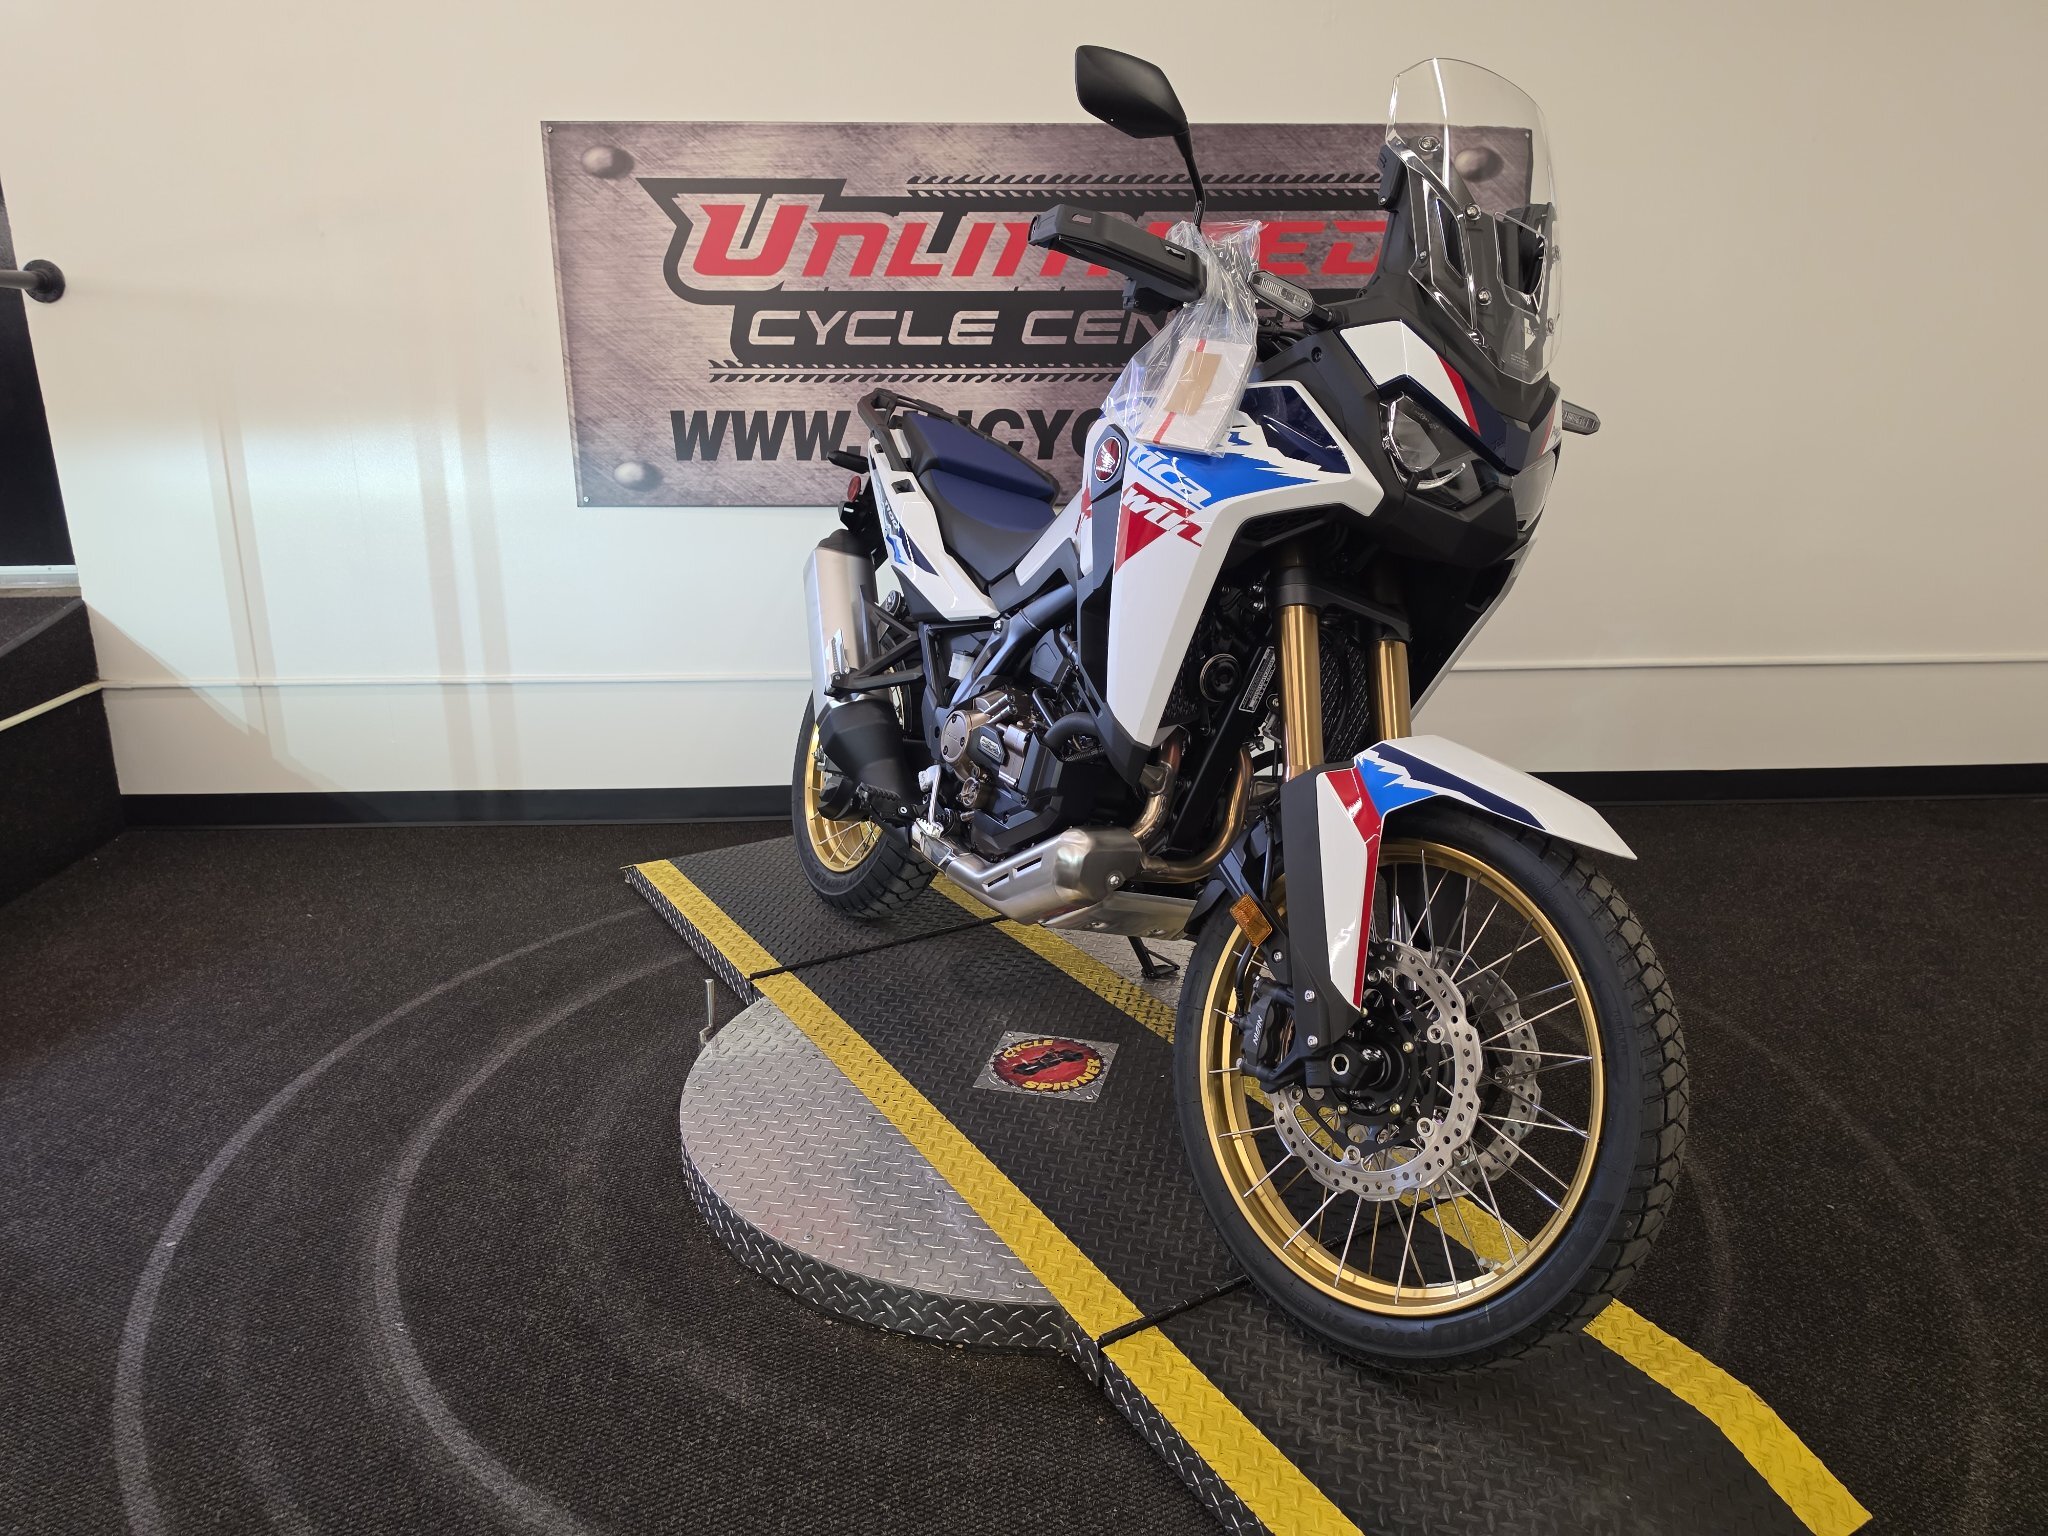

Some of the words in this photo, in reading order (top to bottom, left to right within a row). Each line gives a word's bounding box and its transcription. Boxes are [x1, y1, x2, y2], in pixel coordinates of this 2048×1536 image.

[748, 310, 1000, 346] CYCLE
[1003, 1039, 1054, 1059] CYCLE
[1022, 1058, 1101, 1091] SPINNER
